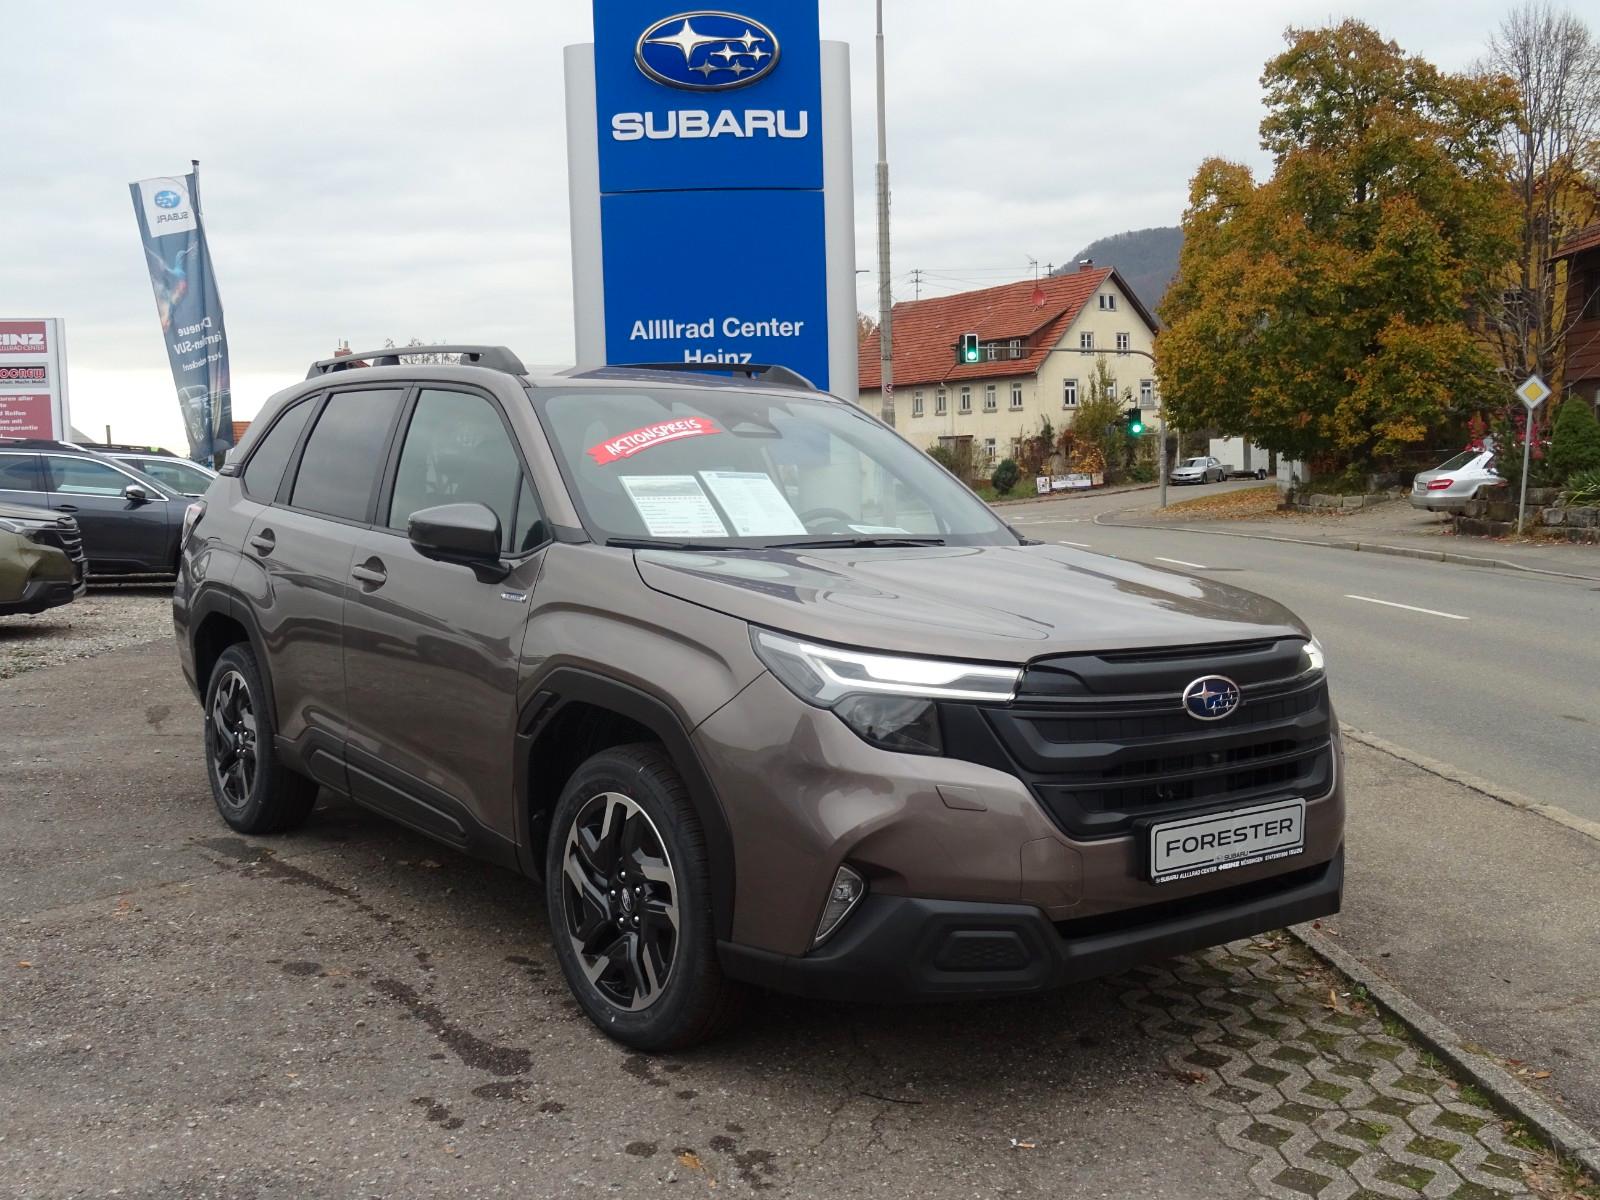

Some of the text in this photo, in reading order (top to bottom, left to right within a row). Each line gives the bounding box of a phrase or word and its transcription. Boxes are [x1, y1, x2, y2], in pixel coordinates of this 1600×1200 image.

[611, 109, 808, 141] SUBARU
[630, 317, 804, 340] Allllrad Center
[684, 349, 753, 364] Heinz
[604, 419, 702, 456] AKTIONSPREIS
[1166, 817, 1293, 857] FORESTER
[1224, 850, 1249, 861] SUBARU
